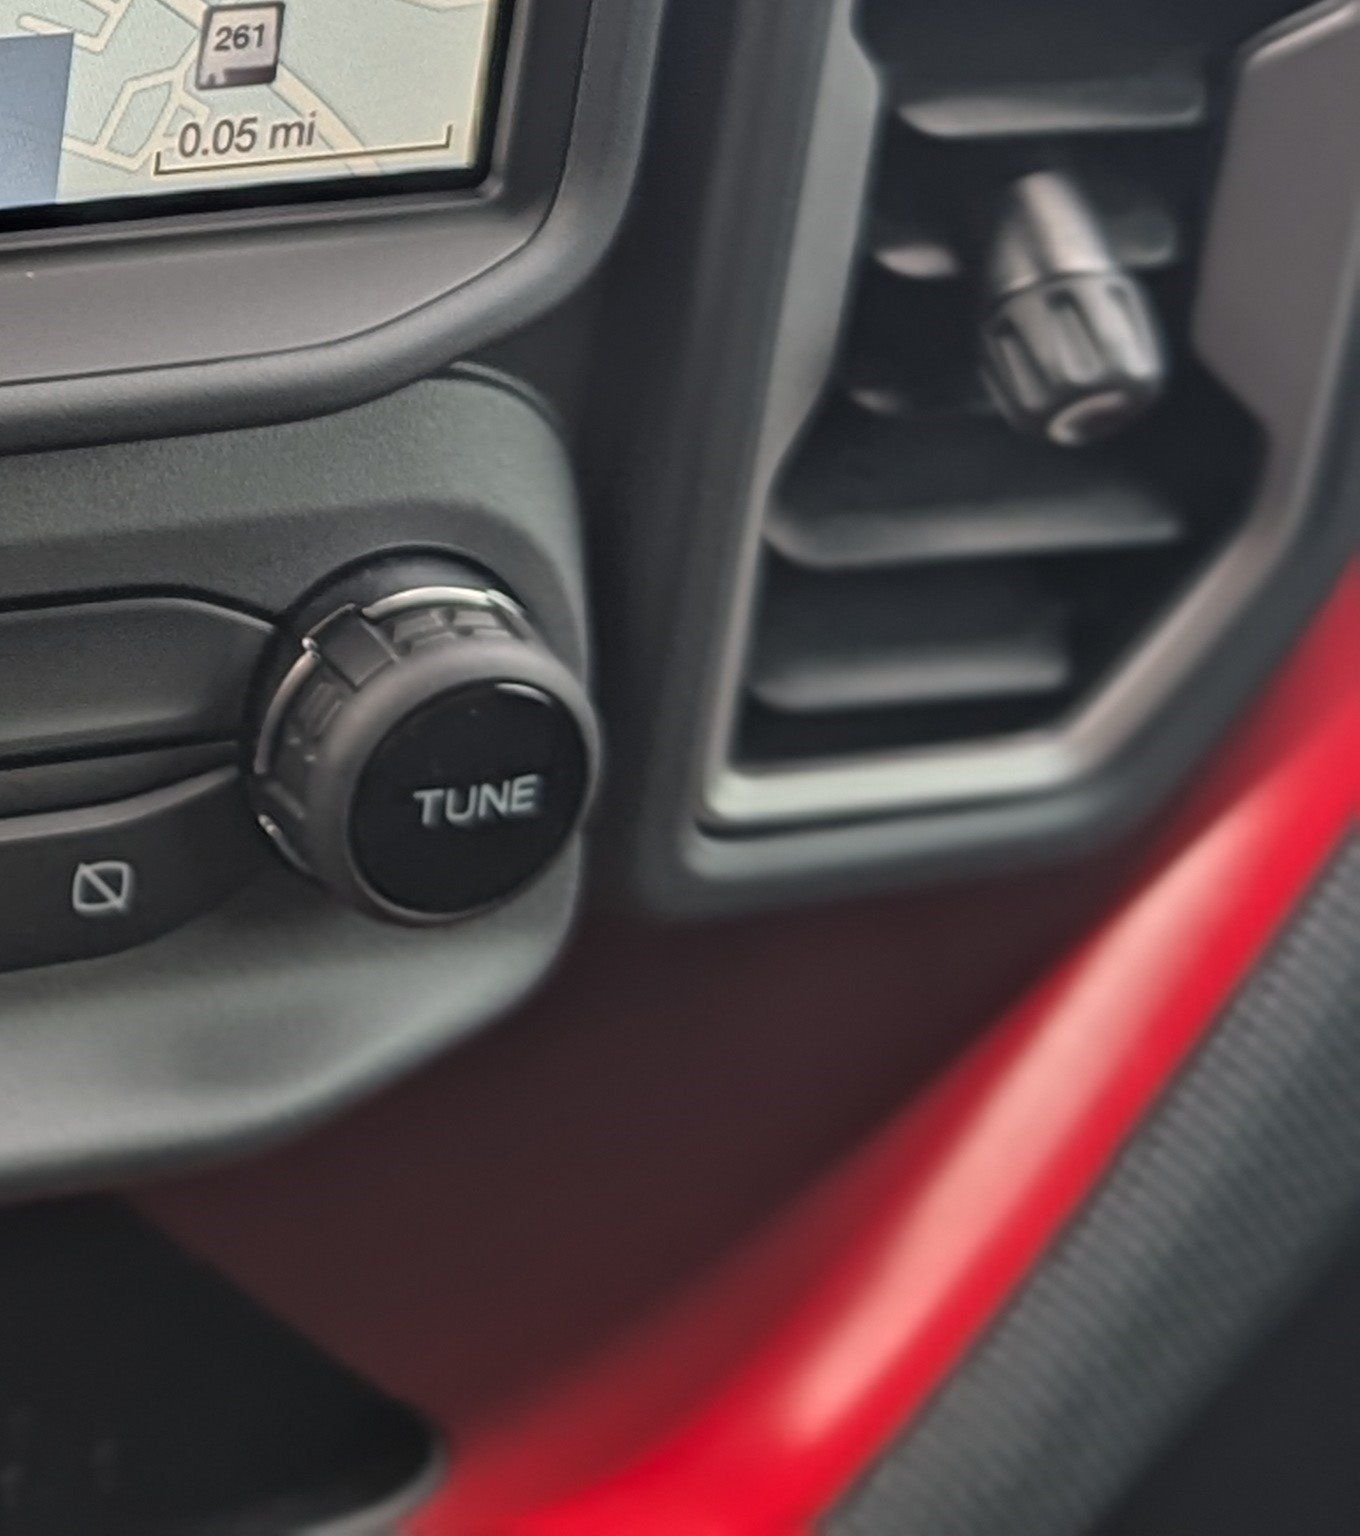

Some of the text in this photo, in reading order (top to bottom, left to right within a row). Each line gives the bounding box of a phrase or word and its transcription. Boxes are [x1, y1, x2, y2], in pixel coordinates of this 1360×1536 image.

[213, 23, 266, 52] 261
[178, 110, 318, 158] 0.05 mi
[412, 773, 539, 826] TUNE
